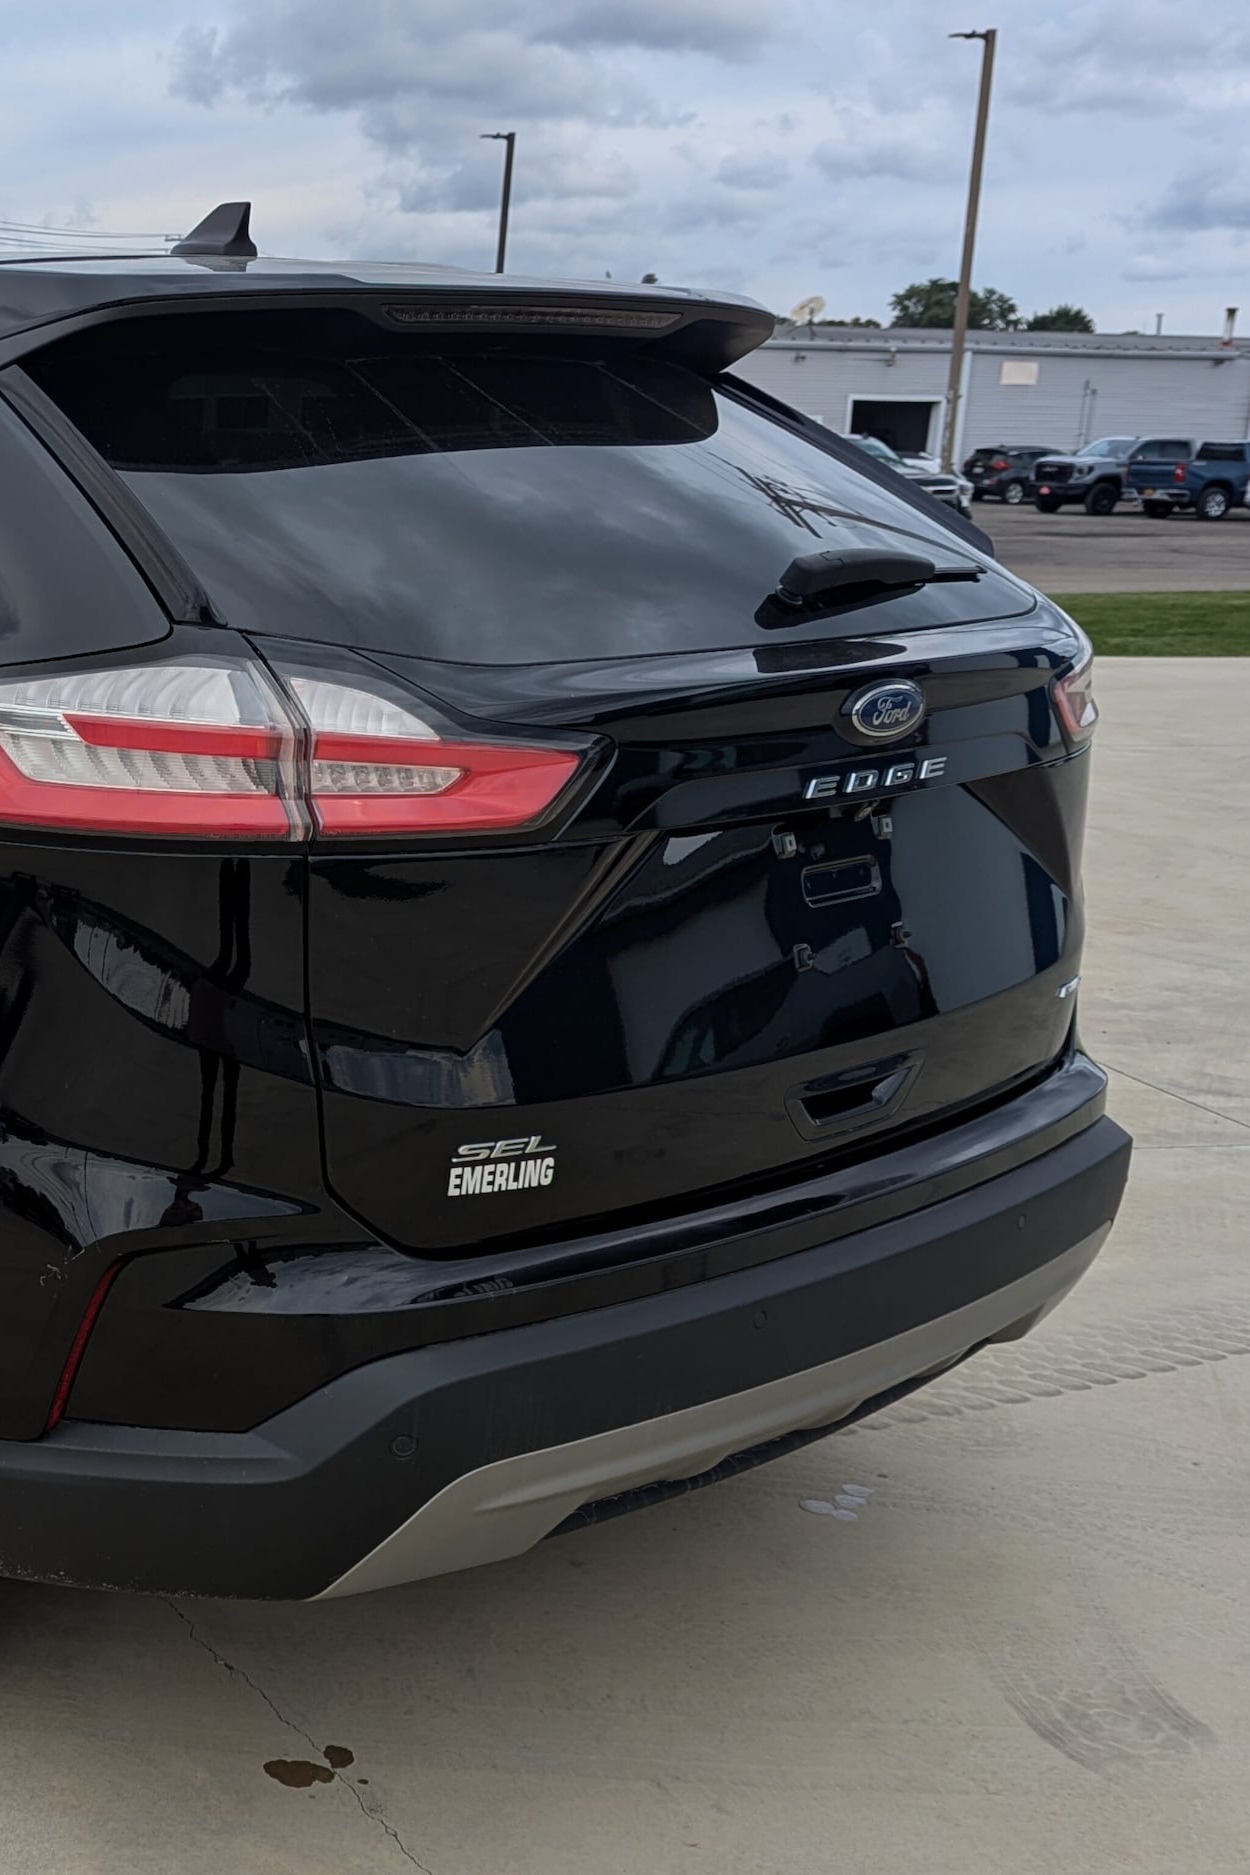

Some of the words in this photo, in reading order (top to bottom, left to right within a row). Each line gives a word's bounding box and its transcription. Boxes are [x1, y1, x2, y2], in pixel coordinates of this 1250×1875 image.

[872, 695, 912, 726] Ford
[803, 755, 948, 800] EDGE
[451, 1135, 558, 1163] SEL
[447, 1156, 556, 1197] EMERLING
